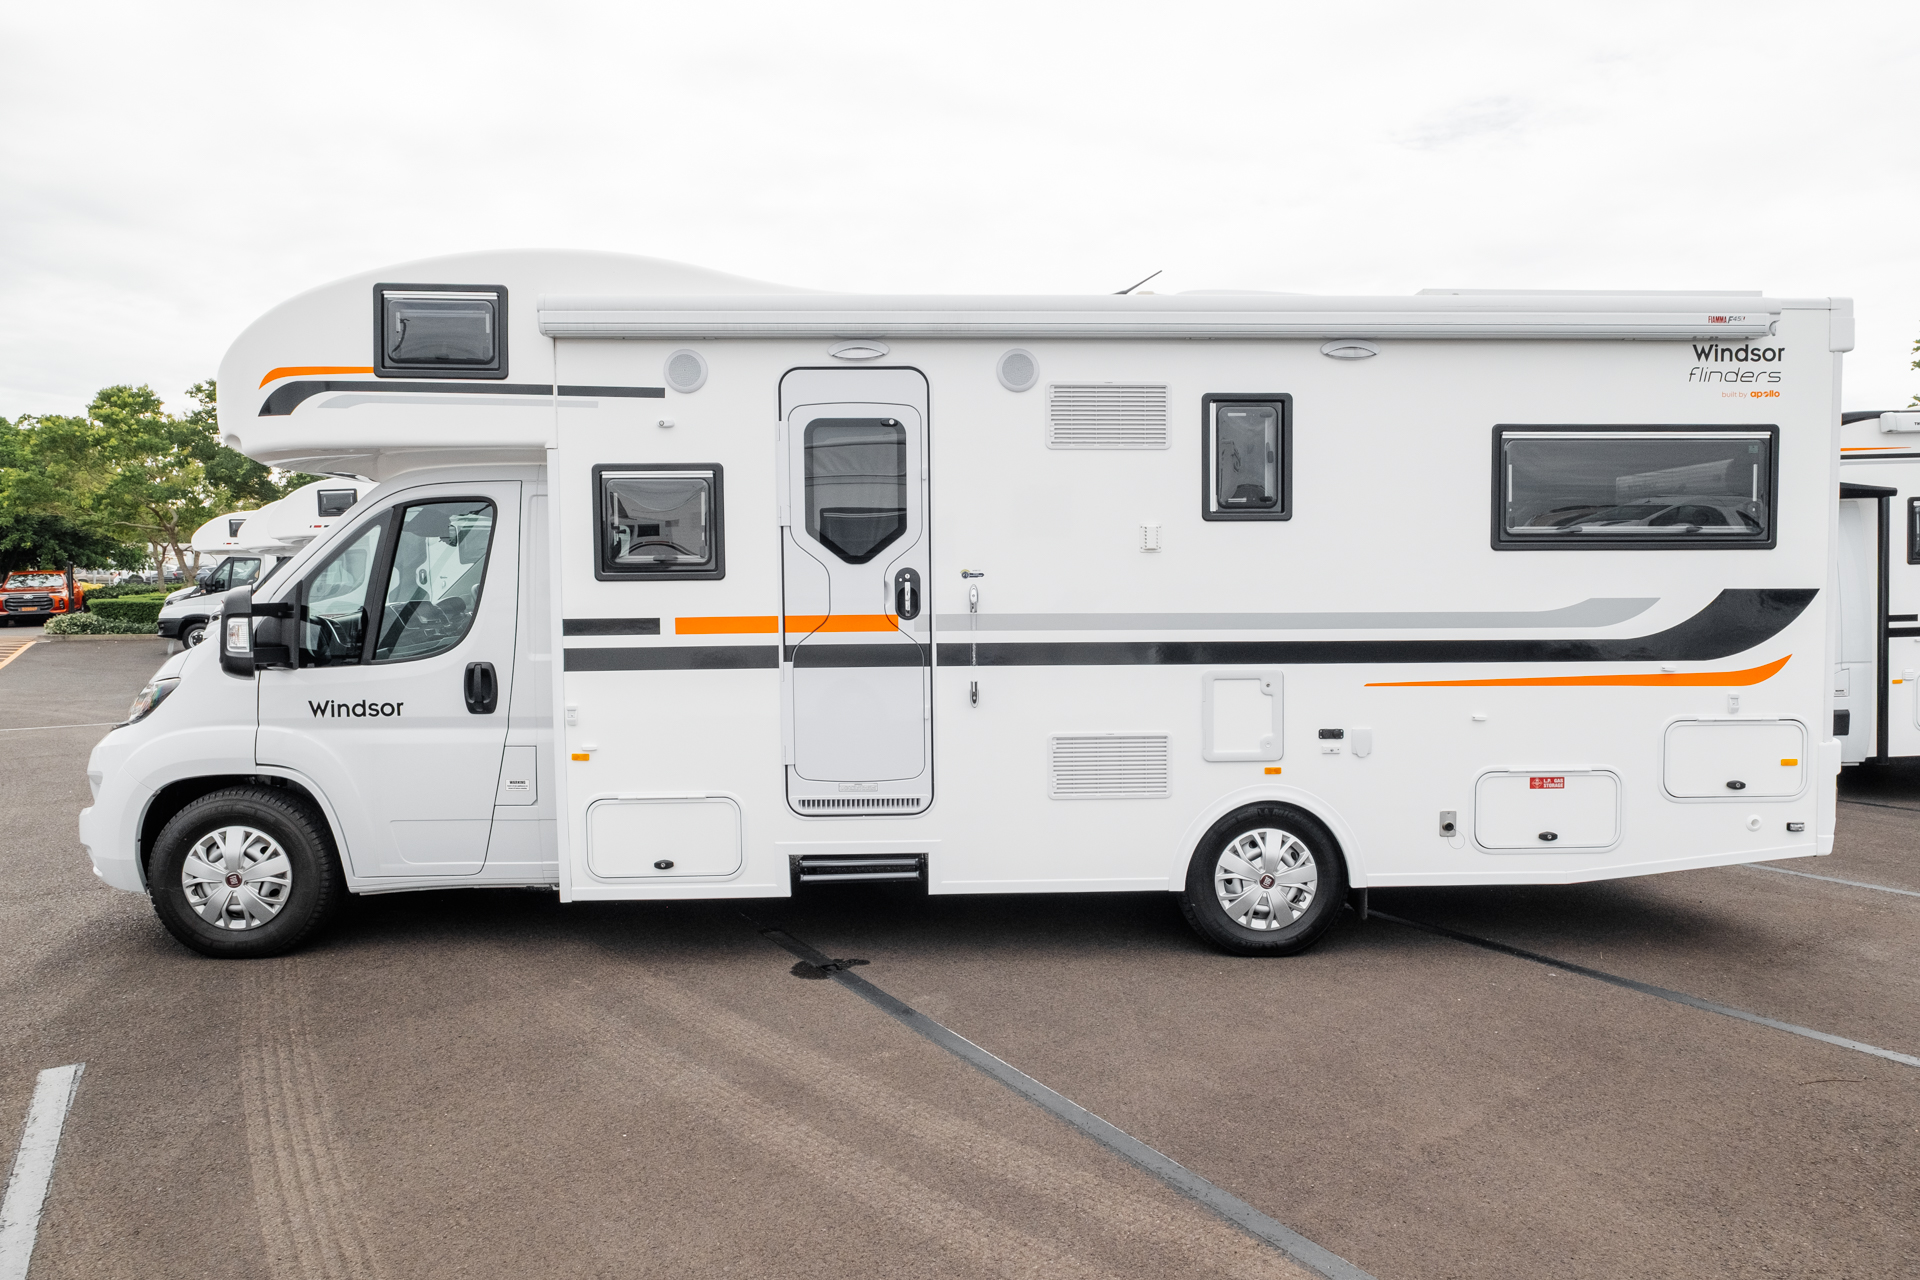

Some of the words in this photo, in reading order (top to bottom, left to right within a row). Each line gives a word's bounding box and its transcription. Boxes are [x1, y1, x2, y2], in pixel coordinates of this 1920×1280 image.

[1708, 316, 1727, 324] FIAMMA
[1692, 344, 1786, 362] Windsor
[1688, 366, 1782, 382] flinders
[1738, 391, 1748, 399] by
[1750, 390, 1780, 399] apollo
[308, 700, 404, 718] Windsor
